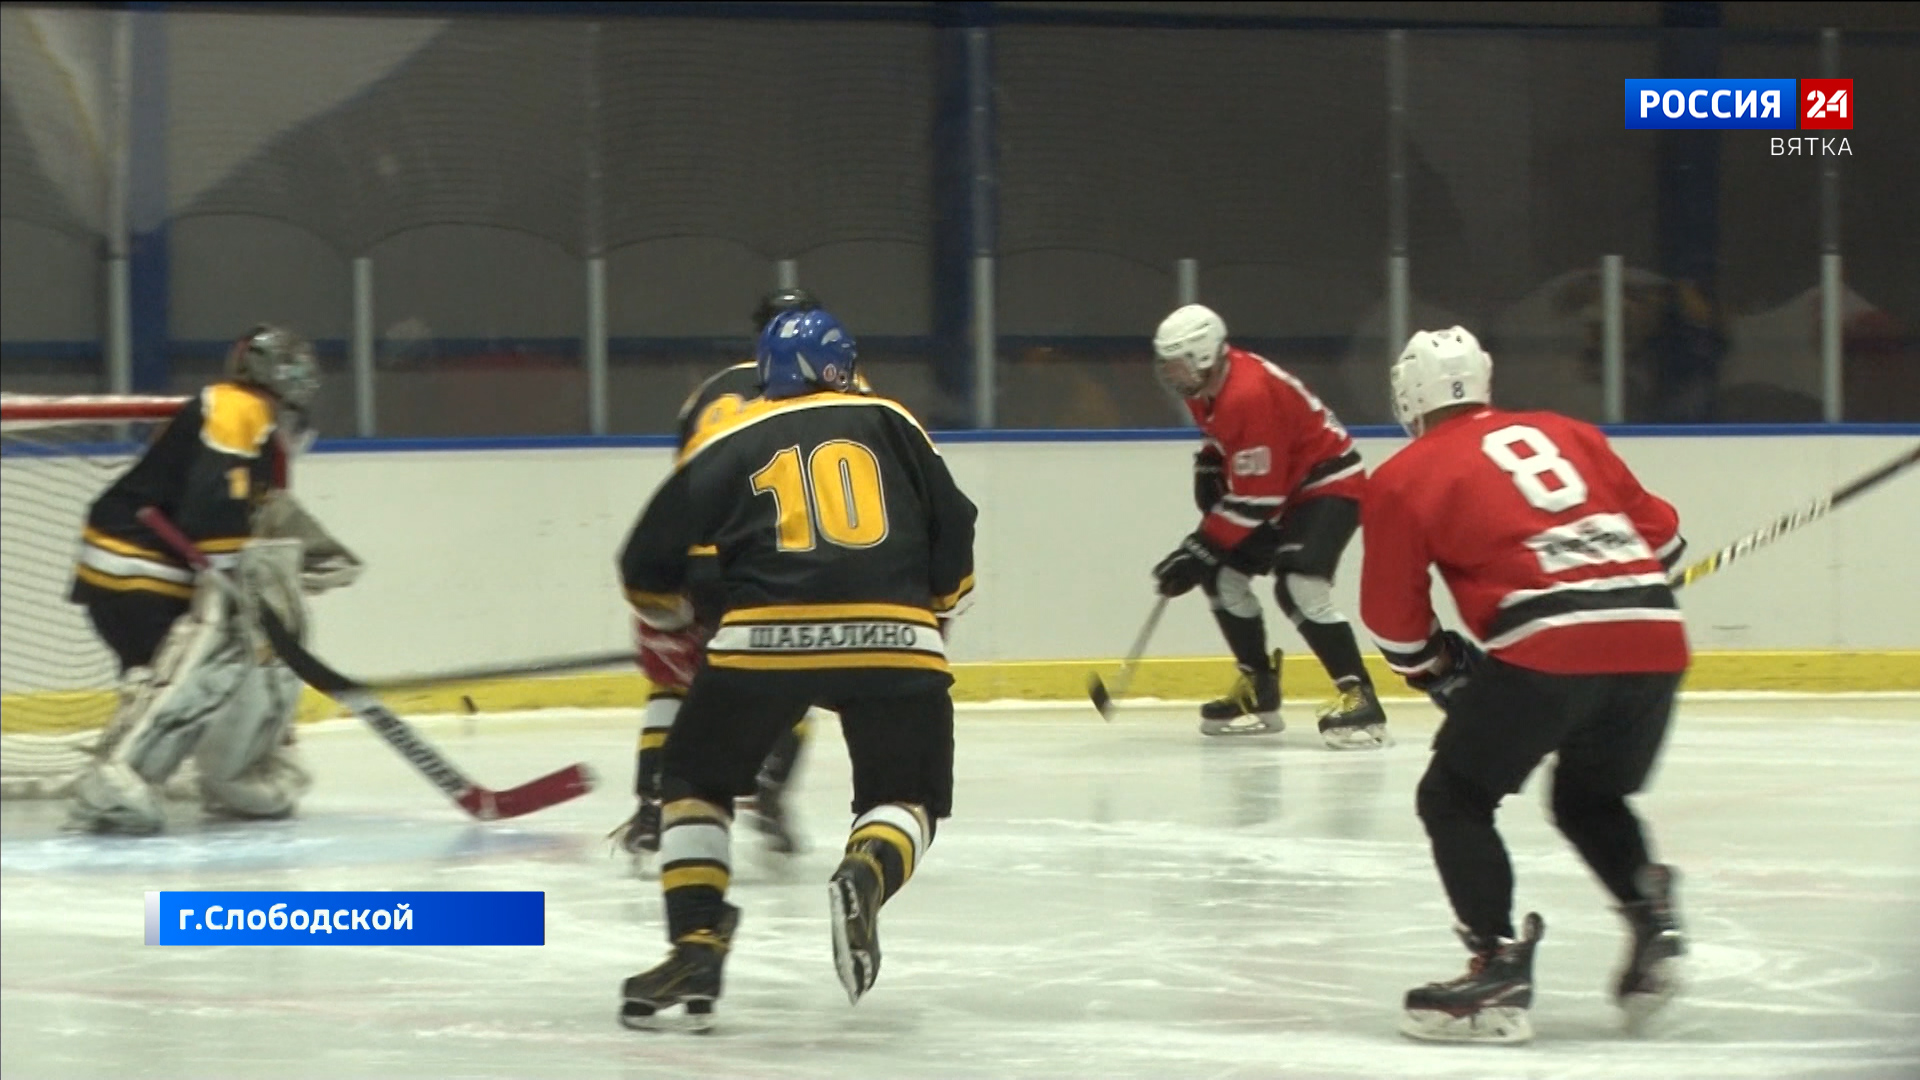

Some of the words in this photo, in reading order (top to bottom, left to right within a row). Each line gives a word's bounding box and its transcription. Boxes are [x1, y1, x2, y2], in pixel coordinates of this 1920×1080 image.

[1452, 381, 1465, 400] 8
[749, 438, 889, 552] 10
[1481, 424, 1588, 513] 8
[750, 624, 917, 649] ШАБАЛИНО
